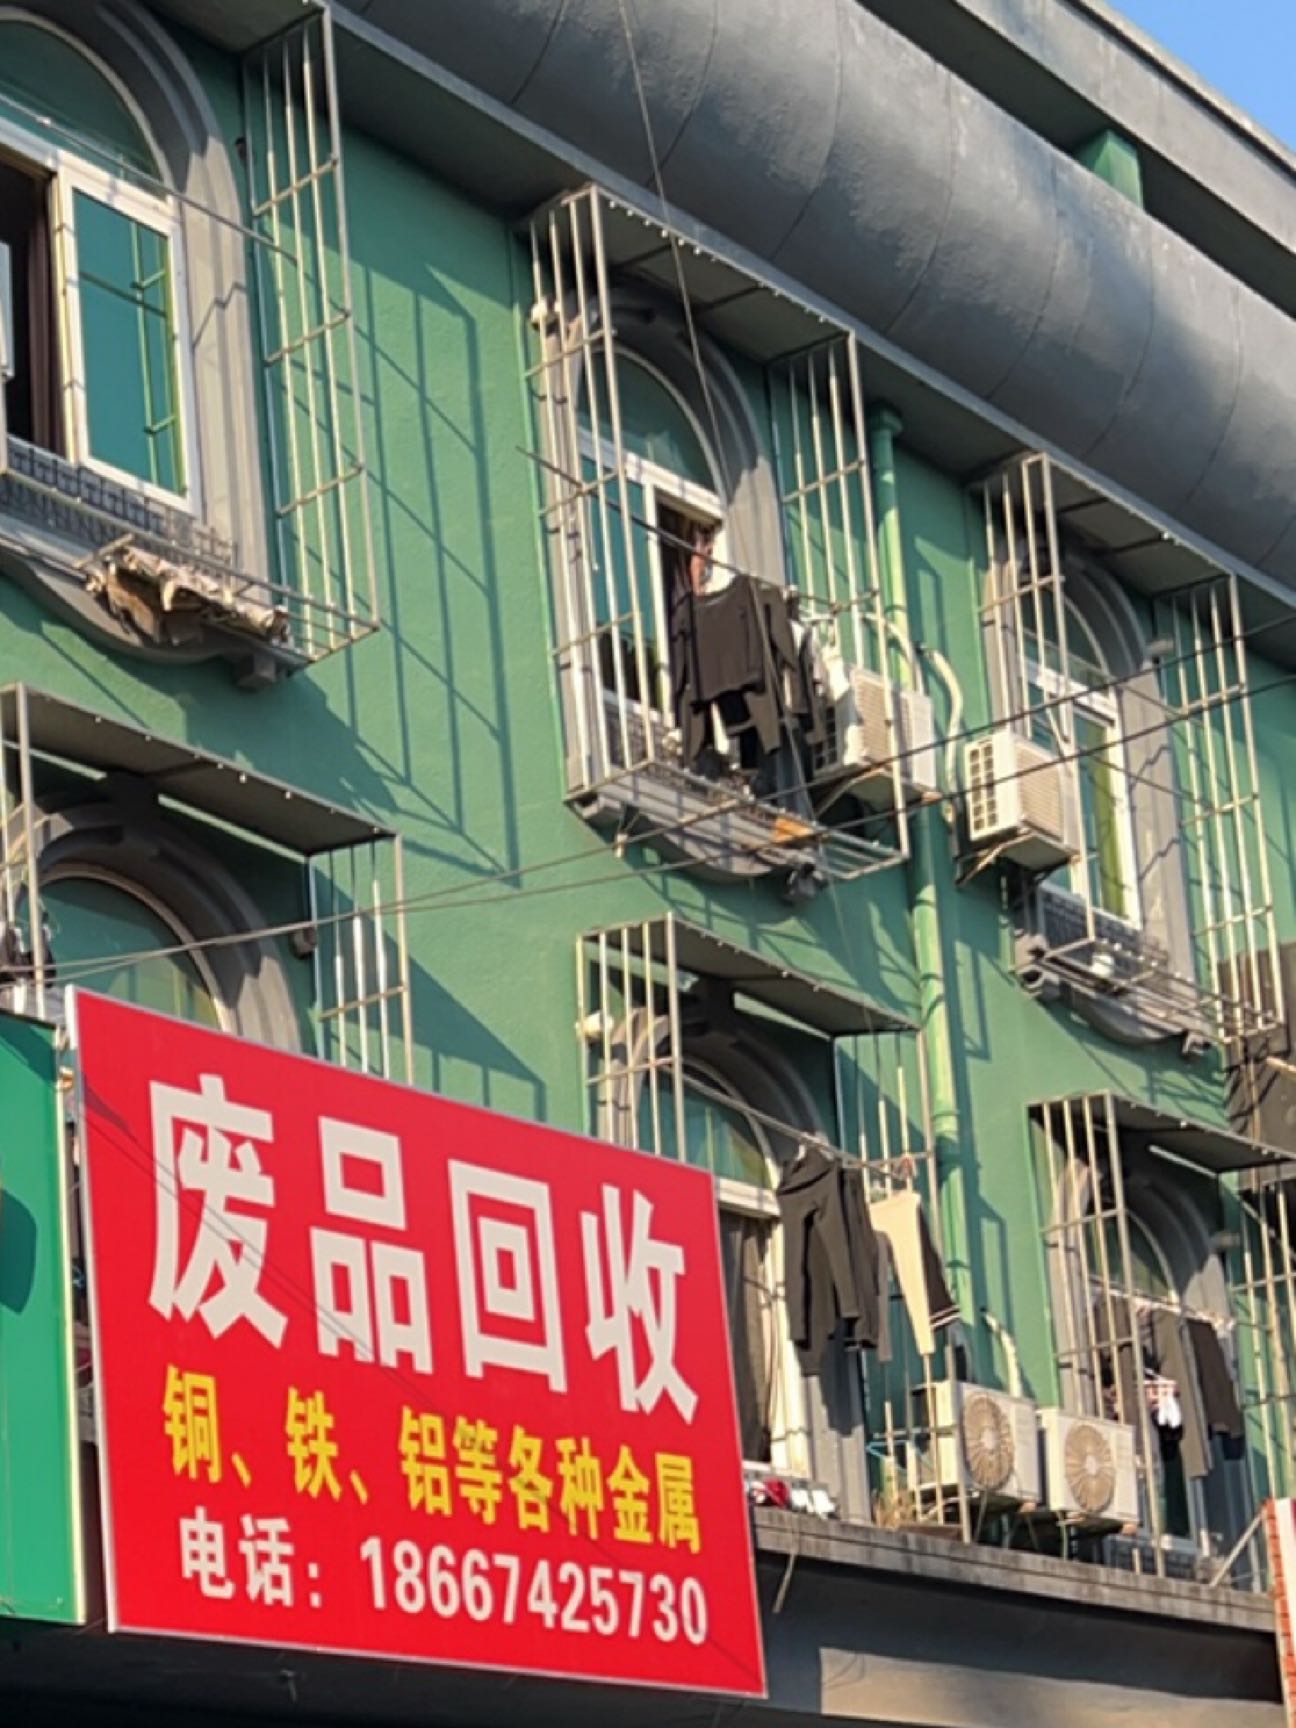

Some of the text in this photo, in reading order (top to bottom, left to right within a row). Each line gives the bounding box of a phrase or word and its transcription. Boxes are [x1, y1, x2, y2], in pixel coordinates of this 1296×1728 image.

[148, 1073, 699, 1424] 废品回收
[162, 1365, 702, 1554] 铜、铁、铝等各种金属
[360, 1536, 706, 1646] 18667425730
